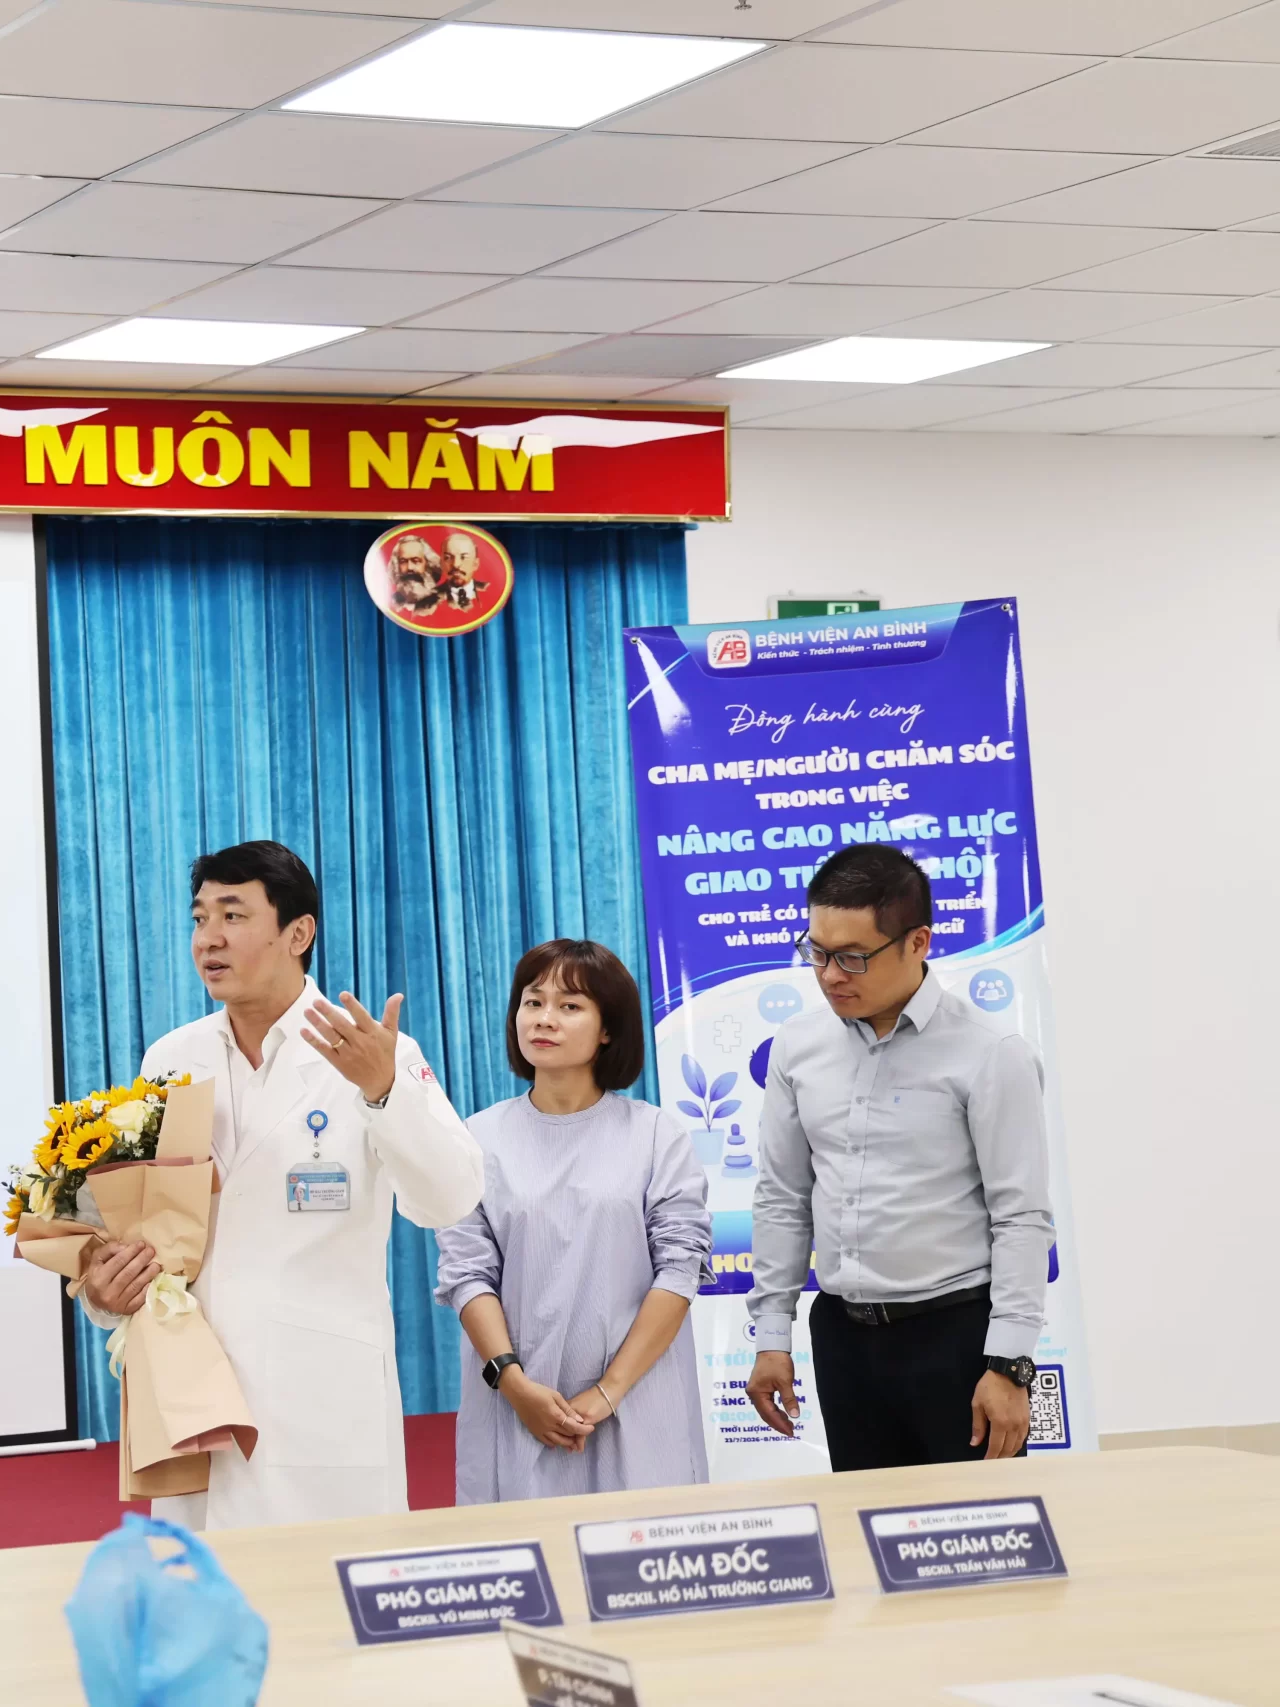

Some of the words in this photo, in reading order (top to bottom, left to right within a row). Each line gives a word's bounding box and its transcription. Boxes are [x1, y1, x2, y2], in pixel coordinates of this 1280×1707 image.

[24, 411, 310, 487] MUÔN
[349, 417, 554, 491] NĂM
[755, 631, 804, 649] BỆNH
[808, 626, 848, 644] VIỆN
[853, 624, 879, 639] AN
[883, 620, 928, 637] BÌNH
[757, 650, 777, 660] Kiến
[778, 648, 800, 659] thức
[809, 647, 834, 656] Trách
[836, 644, 865, 655] nhiệm
[893, 639, 927, 650] thương
[724, 702, 796, 744] Đồng
[802, 699, 863, 725] hành
[868, 703, 925, 734] cùng
[647, 763, 709, 785] CHA
[713, 746, 860, 786] MẸ/NGƯỜI
[866, 739, 953, 770] CHĂM
[959, 736, 1016, 764] SÓC
[755, 788, 845, 809] TRONG
[849, 778, 909, 807] VIỆC
[657, 824, 755, 857] NÂNG
[762, 823, 833, 850] CAO
[840, 811, 941, 845] NĂNG
[947, 808, 1018, 845] LỰC
[684, 868, 772, 895] GIAO
[698, 912, 735, 926] CHO
[738, 903, 772, 923] TRẺ
[774, 904, 798, 921] CÓ
[724, 930, 750, 947] VÀ
[752, 927, 792, 945] KHÓ
[721, 1521, 739, 1532] AN
[897, 1539, 938, 1561] PHÓ
[942, 1534, 989, 1556] GIÁM
[991, 1528, 1033, 1551] ĐỐC
[638, 1551, 706, 1583] GIÁM
[711, 1542, 770, 1576] ĐỐC
[376, 1589, 422, 1611] PHÓ
[424, 1582, 478, 1606] GIÁM
[479, 1576, 525, 1601] ĐỐC
[769, 1576, 812, 1592] GIANG
